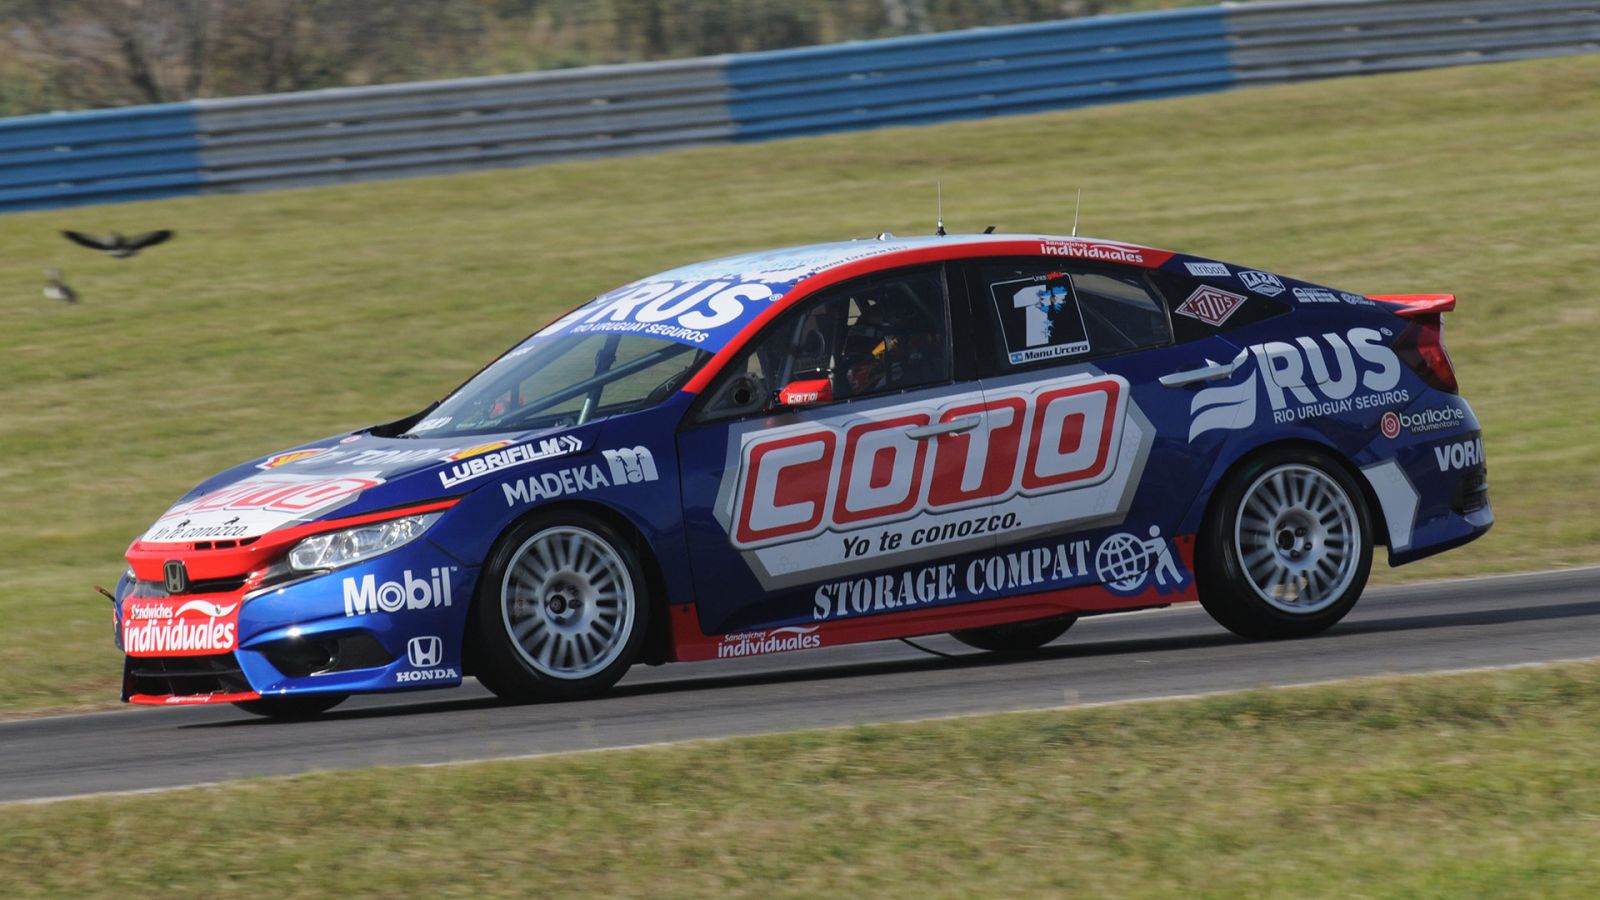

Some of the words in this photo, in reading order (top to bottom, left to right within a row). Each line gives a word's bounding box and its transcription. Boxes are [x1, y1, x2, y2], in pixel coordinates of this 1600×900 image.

[1040, 243, 1143, 263] individuales
[596, 320, 649, 335] URUGUAY
[650, 323, 708, 344] SEGUROS
[1024, 349, 1053, 361] Manu
[1054, 343, 1089, 355] Urcera
[1250, 327, 1401, 410] RUS
[1273, 408, 1295, 424] RIO
[1297, 399, 1353, 420] URUGUAY
[1355, 389, 1410, 410] SEGUROS
[1400, 405, 1464, 428] bariloche
[438, 437, 561, 486] LUBRIFILM
[736, 379, 1121, 544] COTO
[501, 463, 609, 507] MADEKA
[842, 536, 870, 559] Yo
[879, 531, 903, 553] te
[910, 512, 1022, 547] conozco.
[342, 566, 453, 618] Mobil
[813, 571, 957, 621] STORAGE
[966, 539, 1092, 596] COMPAT
[130, 603, 174, 620] Sandwiches
[124, 616, 235, 653] individuales
[717, 632, 821, 659] individuales
[724, 631, 767, 643] Sandwiches
[395, 668, 459, 683] HONDA
